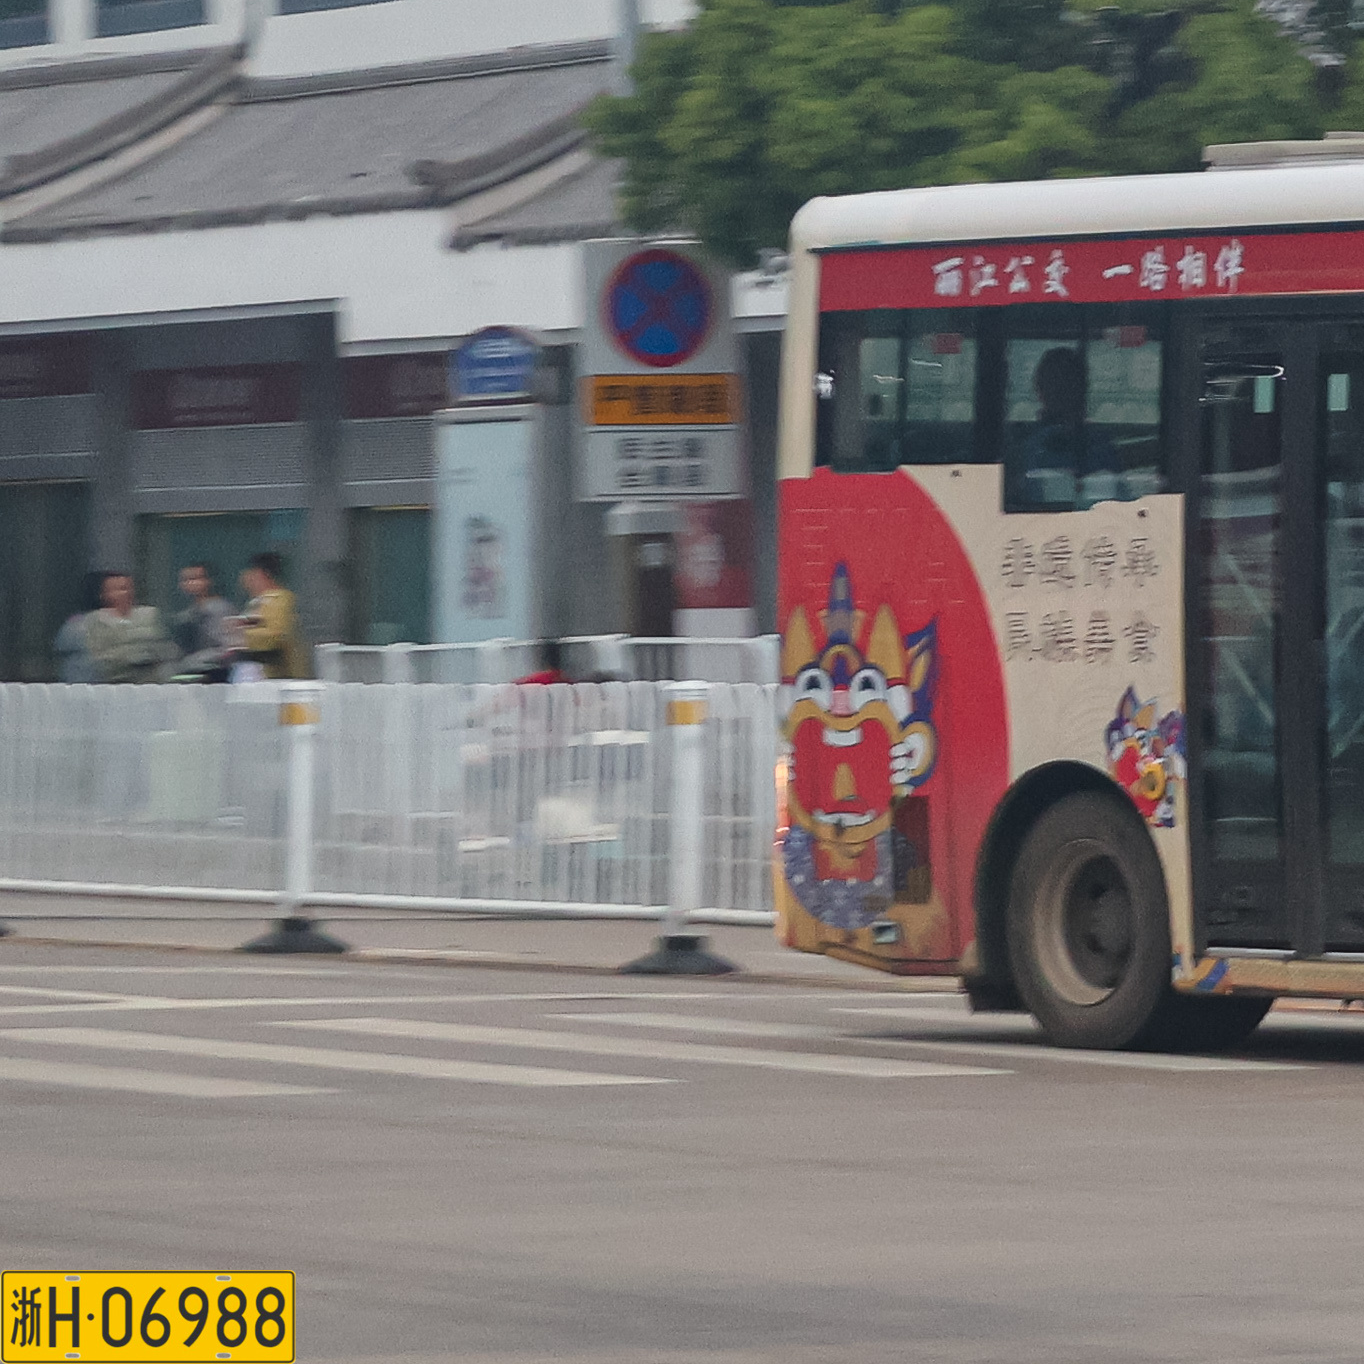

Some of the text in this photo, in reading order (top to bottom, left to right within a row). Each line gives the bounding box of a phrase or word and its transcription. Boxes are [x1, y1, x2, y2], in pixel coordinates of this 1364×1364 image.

[931, 238, 1246, 297] 丽江公交 一路相伴
